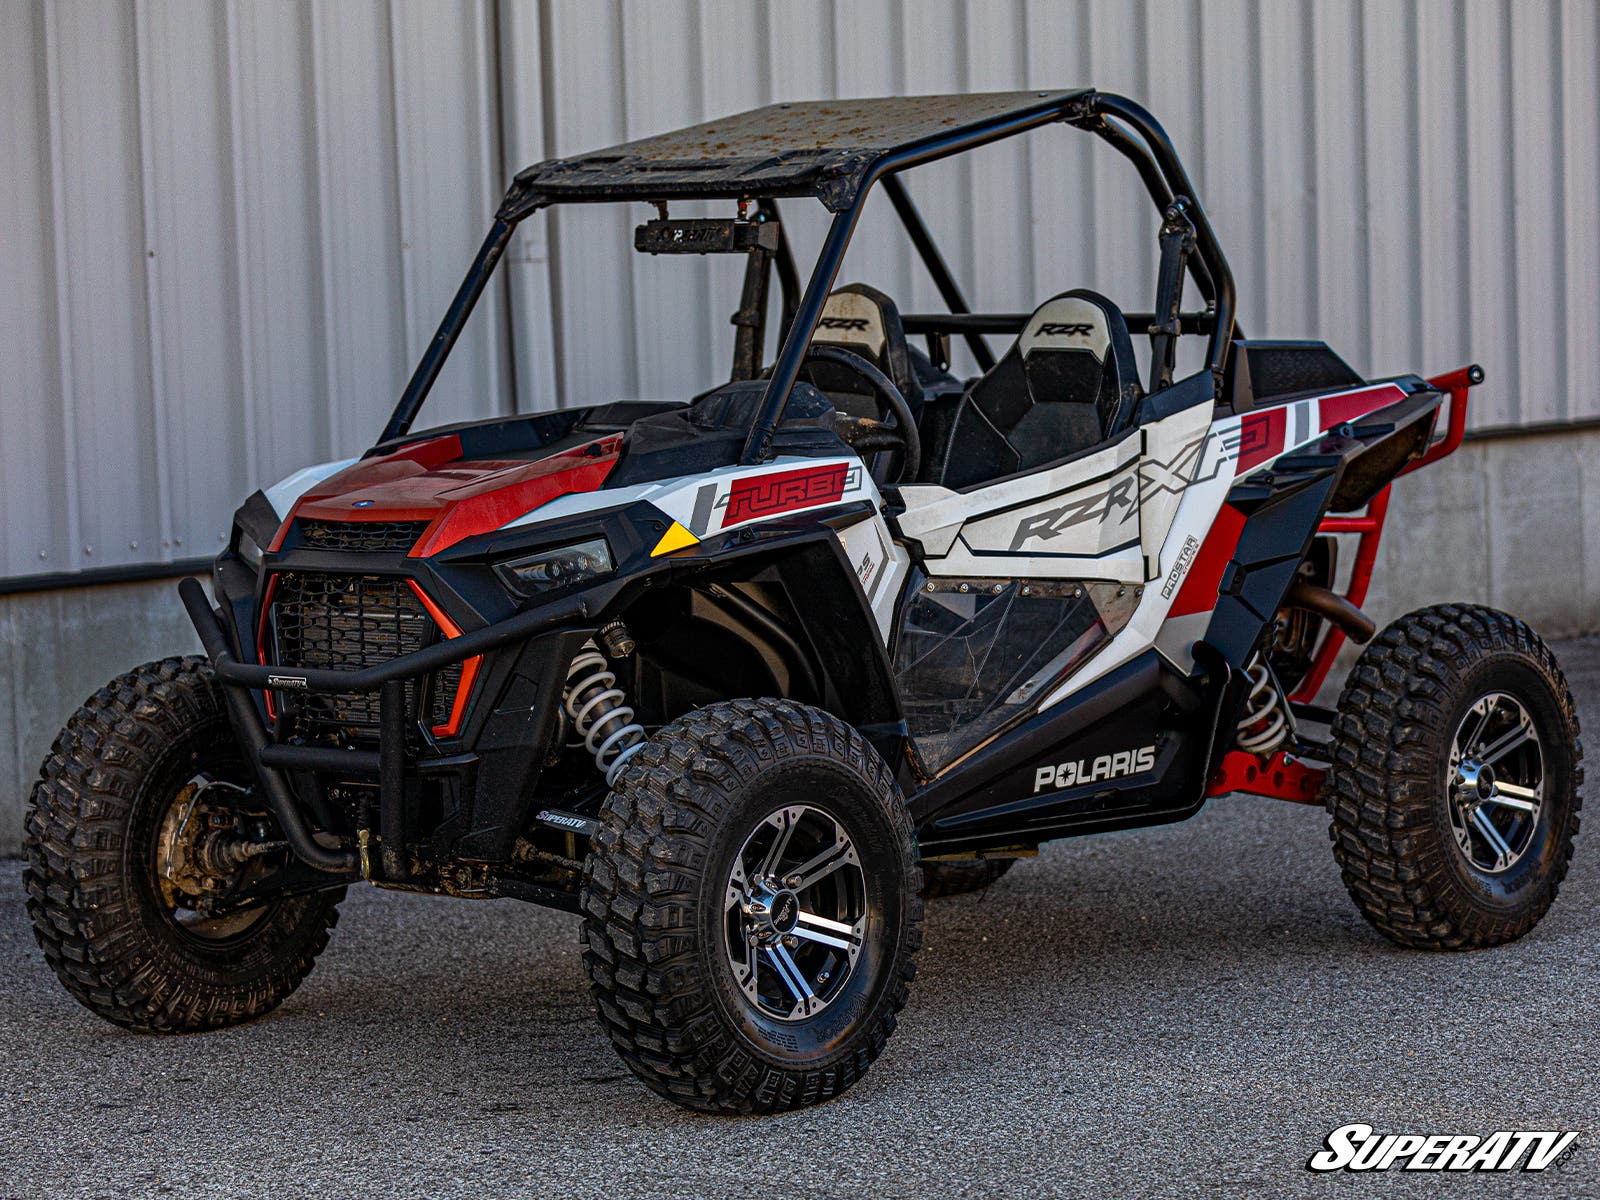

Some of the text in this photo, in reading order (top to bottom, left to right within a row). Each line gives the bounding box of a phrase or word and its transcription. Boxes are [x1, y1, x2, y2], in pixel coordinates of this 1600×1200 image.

[816, 317, 870, 332] RZR
[1034, 323, 1095, 337] RZR
[714, 466, 863, 519] TURBO
[1009, 415, 1270, 552] RZR XP
[1161, 534, 1198, 600] PROSTAR
[1033, 745, 1156, 793] POLARIS
[536, 810, 587, 829] SUPERATV
